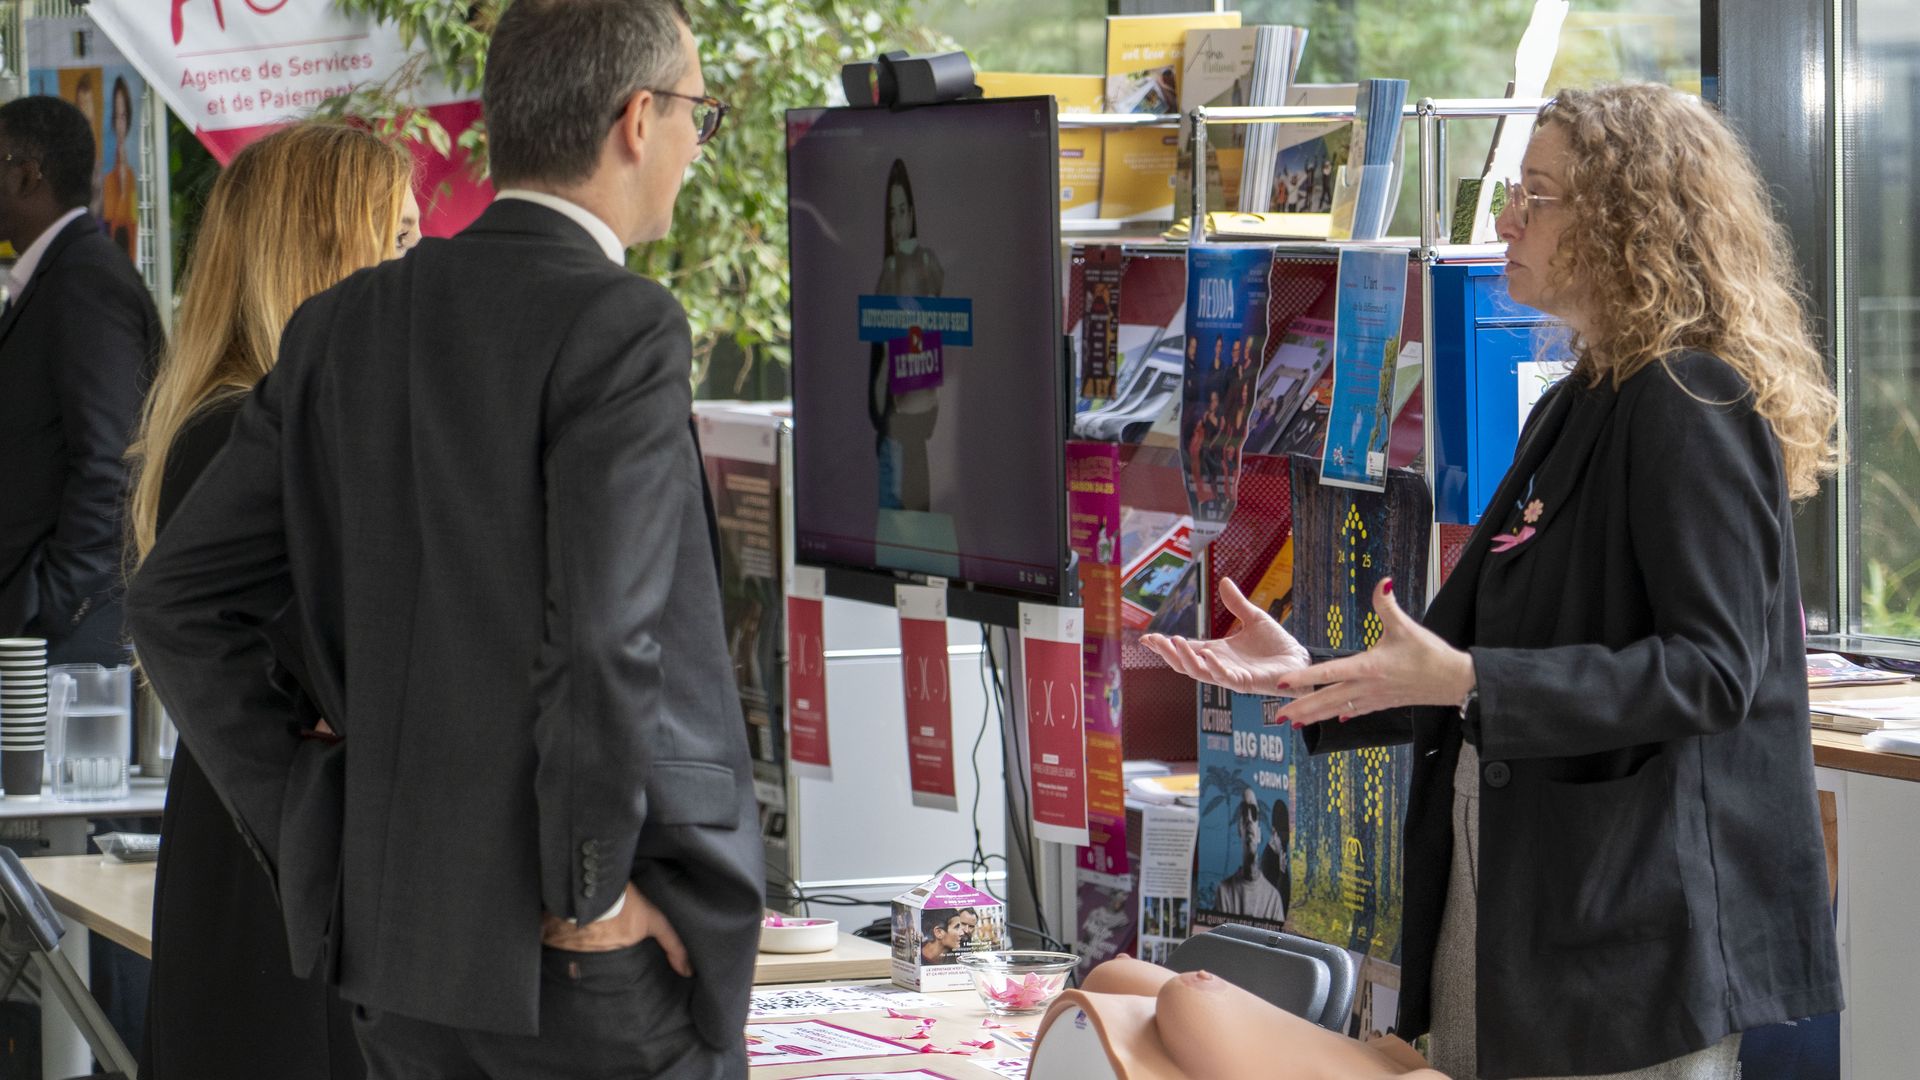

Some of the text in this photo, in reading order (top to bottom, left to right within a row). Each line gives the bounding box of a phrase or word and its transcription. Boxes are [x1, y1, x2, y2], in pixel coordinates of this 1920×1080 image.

[180, 52, 372, 91] Agence de Services
[207, 96, 227, 116] et
[233, 92, 254, 112] de
[1198, 278, 1234, 319] HEDDA
[939, 310, 950, 331] DU
[894, 354, 907, 378] LE
[908, 351, 934, 377] TUTO
[1362, 553, 1372, 568] 25
[1202, 708, 1232, 733] OCTOBRE
[1233, 730, 1284, 762] BIG RED
[1259, 770, 1282, 790] DRUM
